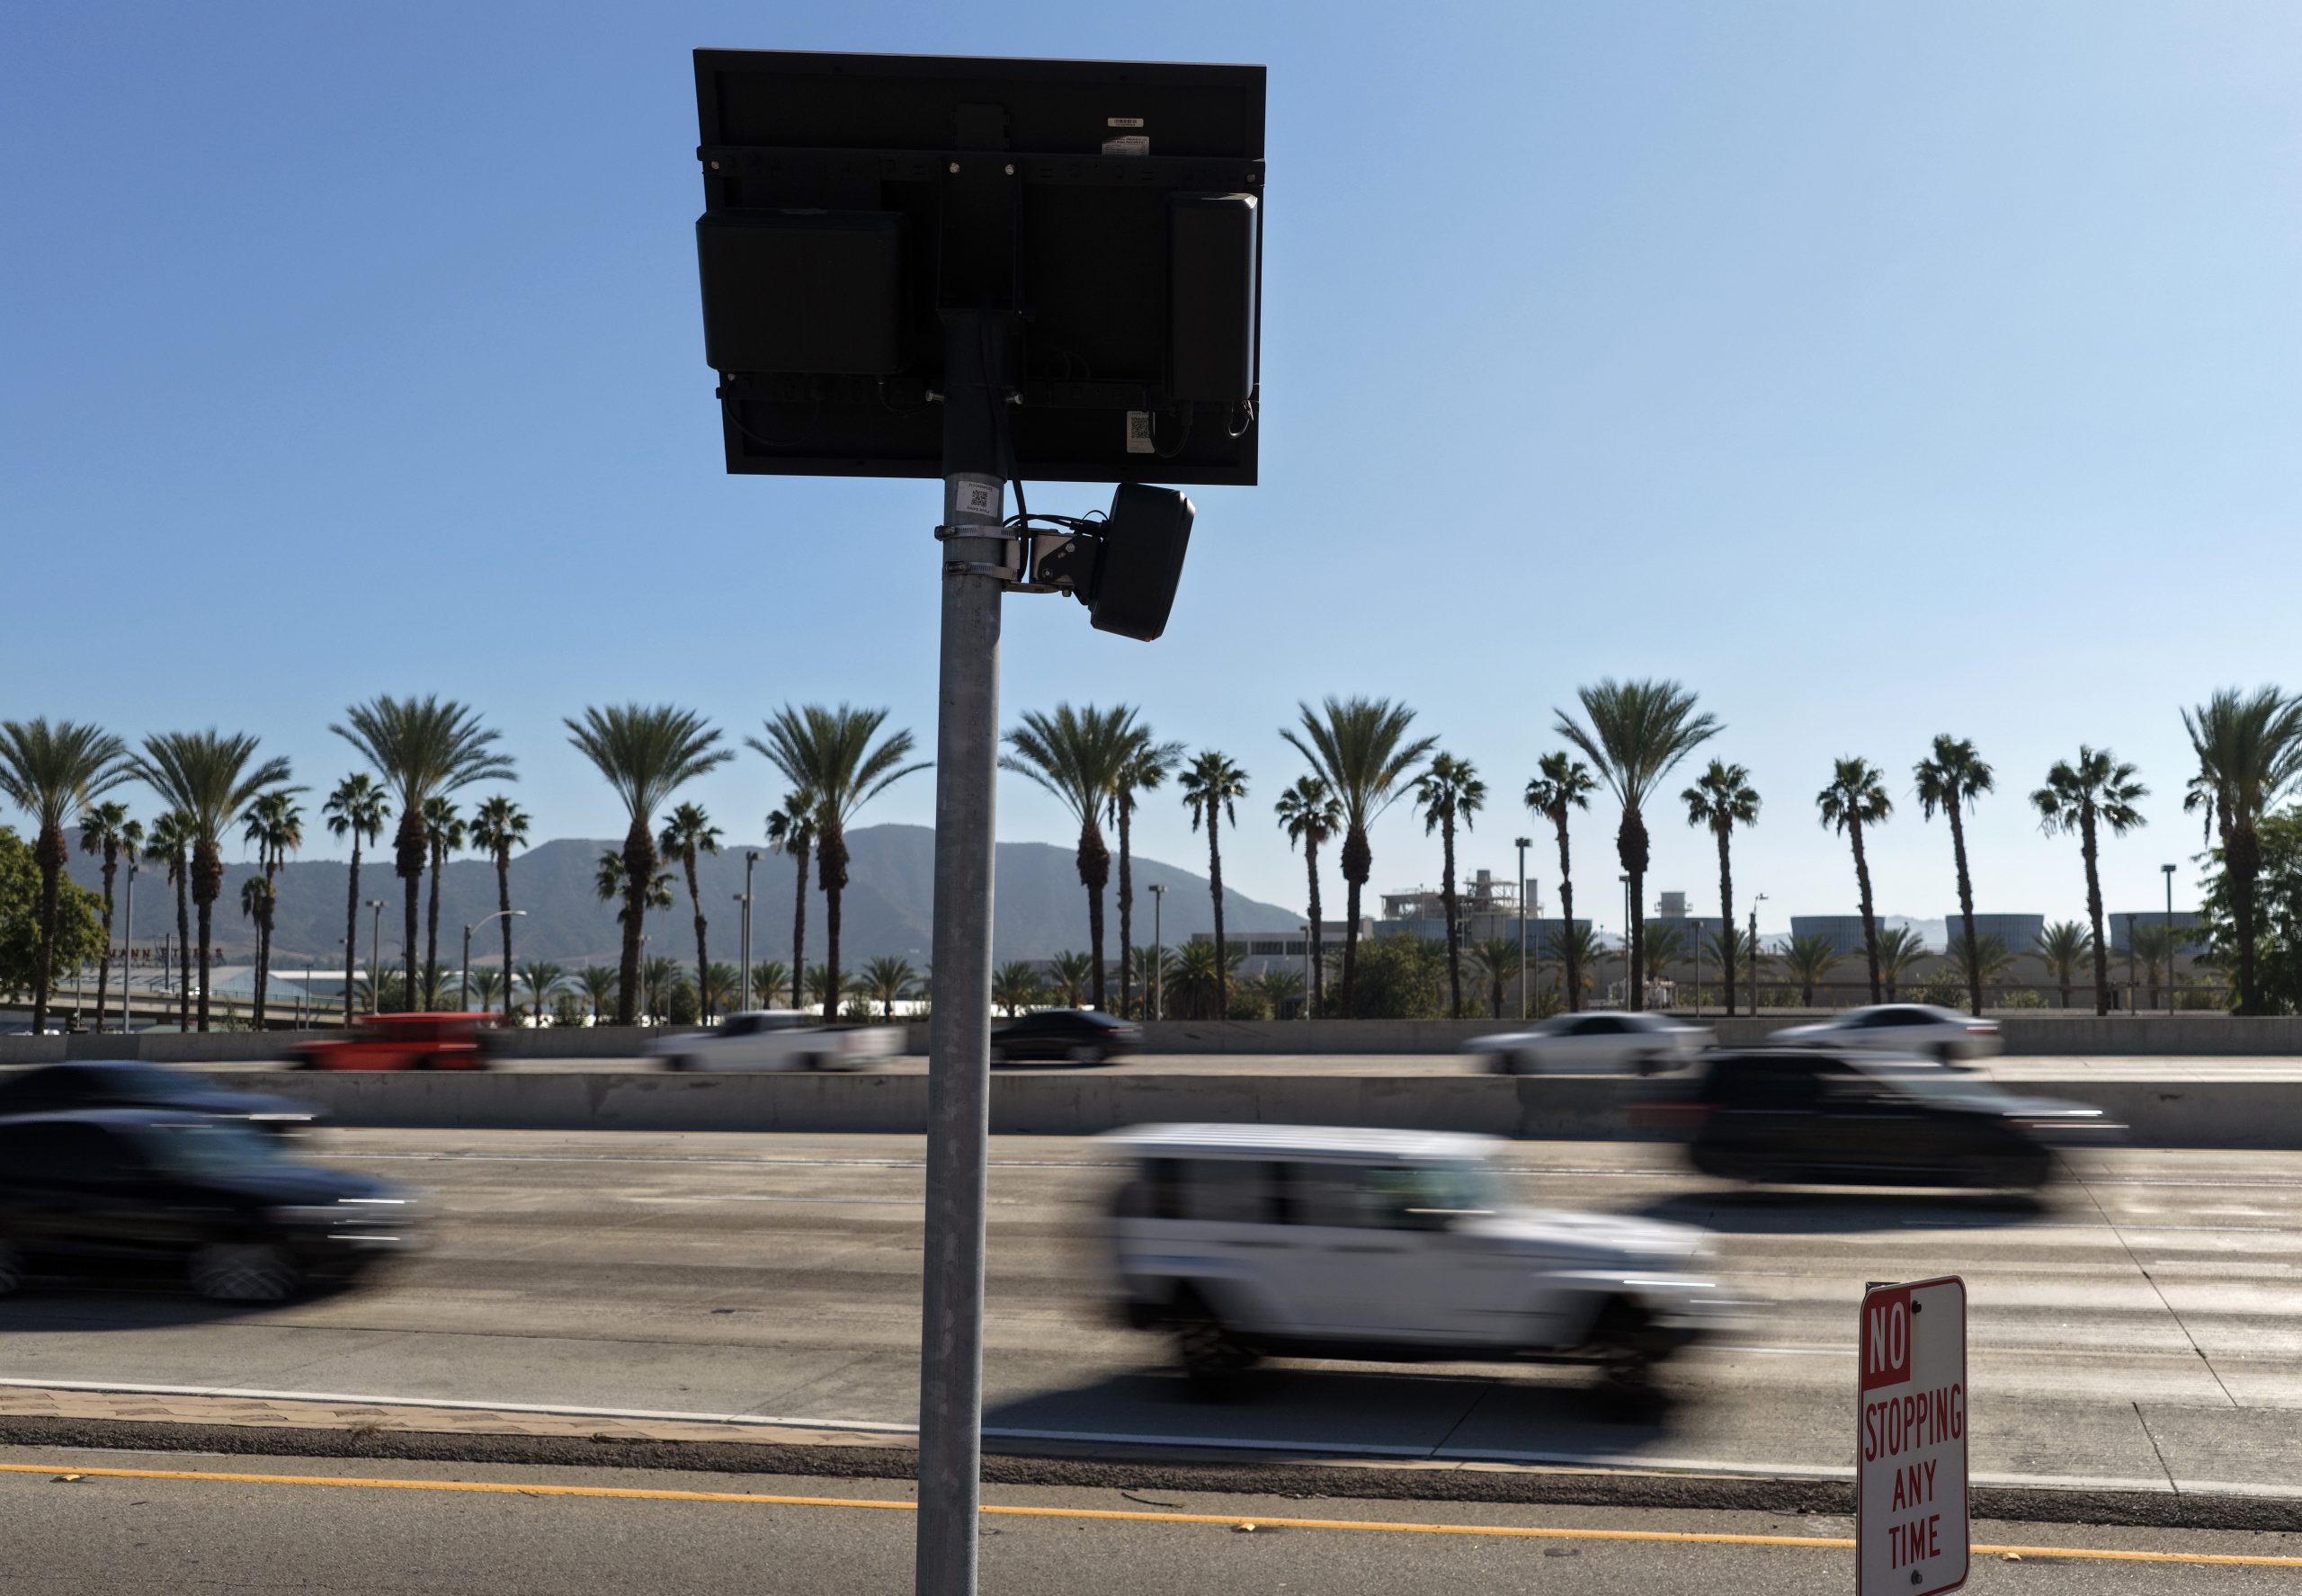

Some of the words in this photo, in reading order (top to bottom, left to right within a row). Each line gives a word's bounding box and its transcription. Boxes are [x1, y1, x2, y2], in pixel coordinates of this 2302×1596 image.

[1869, 1301, 1905, 1375] NO
[1865, 1383, 1962, 1462] STOPPING
[1892, 1458, 1937, 1511] ANY
[1888, 1514, 1941, 1569] TIME
